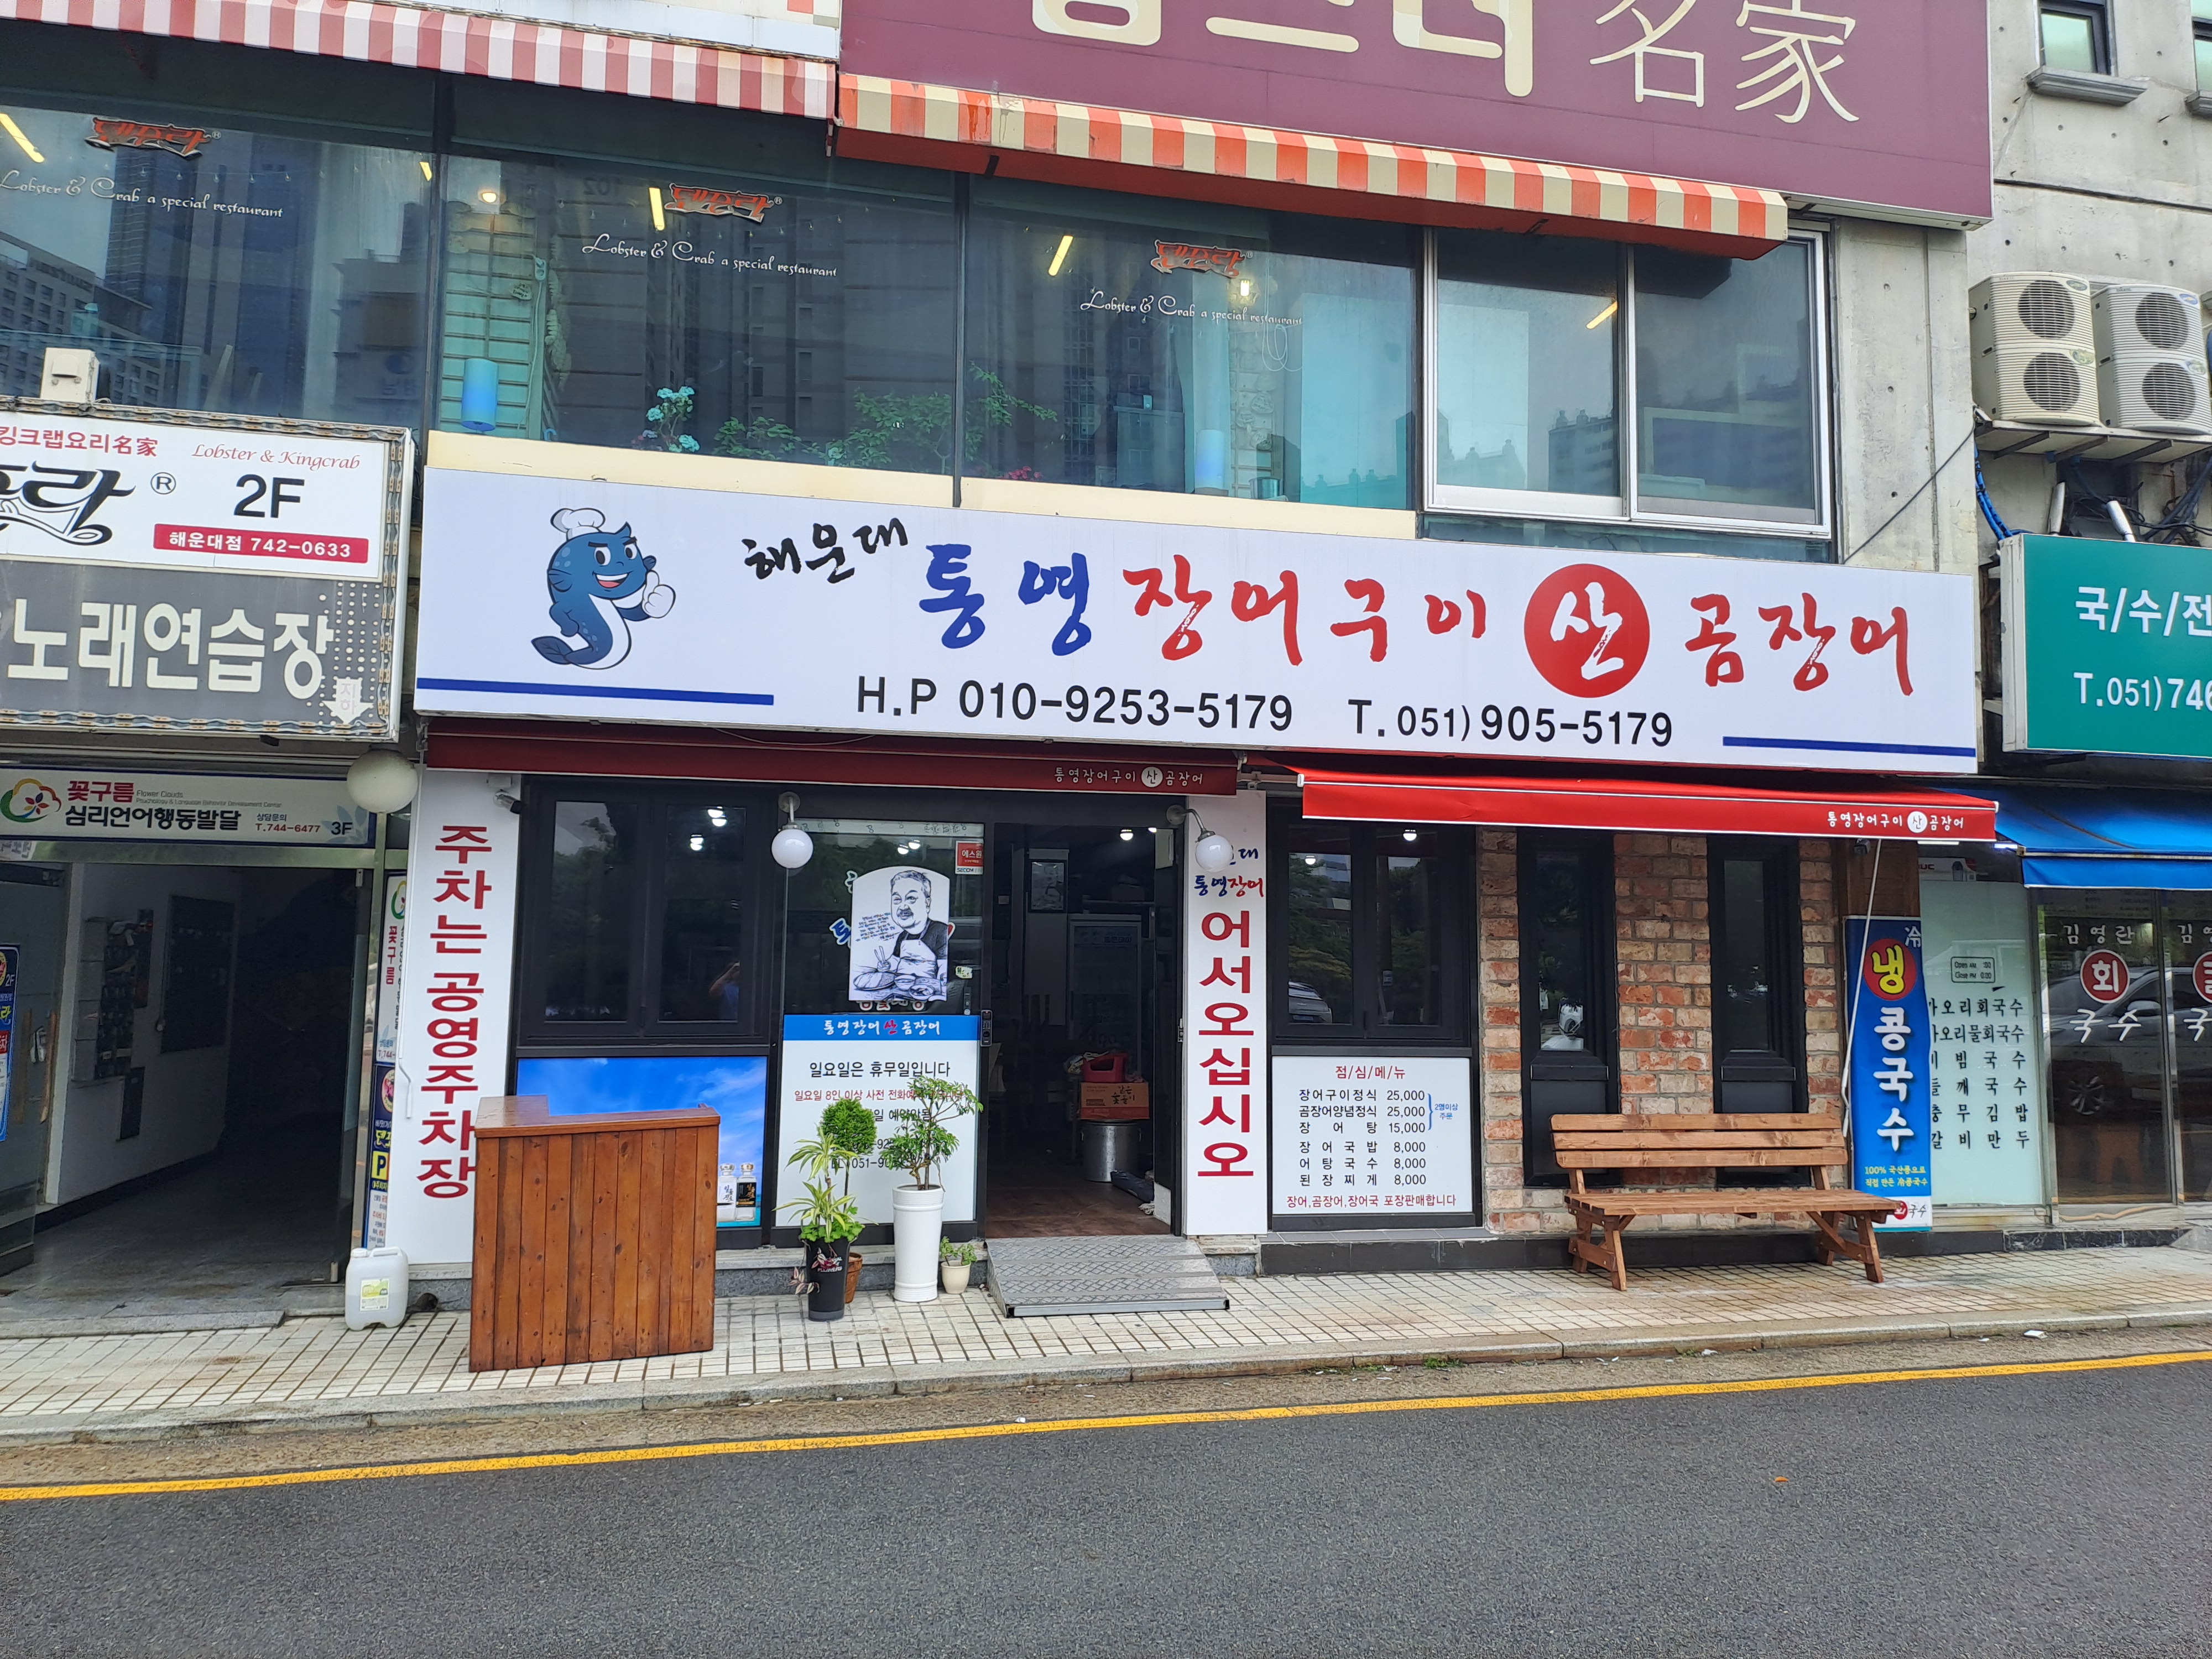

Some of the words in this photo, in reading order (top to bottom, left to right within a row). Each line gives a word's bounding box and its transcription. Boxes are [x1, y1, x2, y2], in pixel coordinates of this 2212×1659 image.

[1, 170, 61, 195] Lobster
[65, 176, 86, 196] &
[91, 178, 139, 203] Crab
[147, 195, 156, 205] a
[161, 194, 210, 212] special
[213, 201, 283, 218] restaurant
[582, 234, 647, 258] Lobster
[651, 240, 667, 258] &
[672, 241, 714, 265] Crab
[721, 258, 729, 266] a
[733, 255, 774, 272] special
[778, 262, 837, 276] restaurant
[1080, 291, 1136, 314] Lobster
[1140, 295, 1154, 312] &
[1158, 296, 1195, 317] Crab
[1211, 307, 1247, 324] special
[1250, 314, 1303, 325] restaurant
[191, 444, 256, 462] Lobster
[261, 448, 275, 463] &
[278, 450, 361, 472] Kingcrab
[0, 460, 137, 546] 랑
[233, 473, 305, 519] 2F
[169, 530, 242, 552] 해운대점
[251, 536, 351, 559] 742-0633
[744, 518, 908, 583] 해운대
[7, 598, 334, 700] 노래연습장
[1551, 582, 1624, 681] 산
[1684, 592, 1914, 697] 곰장어
[339, 681, 358, 716] 지하
[857, 676, 937, 717] H.P
[959, 679, 1293, 732] 010-9253-5179
[1054, 767, 1136, 784] 통영장어구이
[1146, 769, 1158, 785] 산
[1165, 771, 1203, 787] 곰장어
[67, 780, 135, 802] 꽃구름
[65, 805, 242, 831] 심리언어행동발달
[255, 823, 321, 833] T.744-6477
[331, 821, 353, 836] 3F
[257, 813, 288, 822] 상담문의
[1827, 810, 1904, 830] 통영장어구이
[1911, 813, 1924, 830] 산
[1929, 814, 1964, 833] 곰장어
[962, 849, 982, 859] 에스원
[430, 825, 493, 954] 주차는
[2063, 924, 2136, 945] 김영란
[1872, 945, 1905, 994] 냉
[2091, 959, 2120, 993] 회
[884, 1019, 898, 1035] 산
[901, 1020, 940, 1036] 곰장어
[2069, 1009, 2142, 1044] 국수
[1198, 910, 1254, 1177] 어서오십시오
[810, 1061, 864, 1077] 일요일은
[870, 1061, 951, 1078] 휴무일입니다
[1335, 1065, 1406, 1079] 점/심/메/뉴
[1873, 1006, 1914, 1152] 콩국수
[417, 972, 485, 1199] 공영주차장
[794, 1090, 823, 1102] 일요일
[826, 1090, 841, 1101] 8인
[844, 1090, 863, 1100] 이상
[866, 1090, 884, 1101] 사전
[1299, 1089, 1377, 1102] 장어구이정식
[1387, 1090, 1425, 1102] 25,000
[1299, 1105, 1377, 1118] 곰장어양념정식
[1387, 1106, 1425, 1118] 25,000
[1434, 1103, 1458, 1112] 2명이상
[1389, 1123, 1426, 1134] 15,000
[1394, 1142, 1426, 1154] 8,000
[1931, 1130, 2030, 1150] 갈비만두
[1394, 1158, 1426, 1170] 8,000
[1864, 1166, 1886, 1175] 100%
[1394, 1175, 1426, 1186] 8,000
[1881, 1177, 1895, 1187] 만든
[1384, 1194, 1457, 1207] 포장판매합니다
